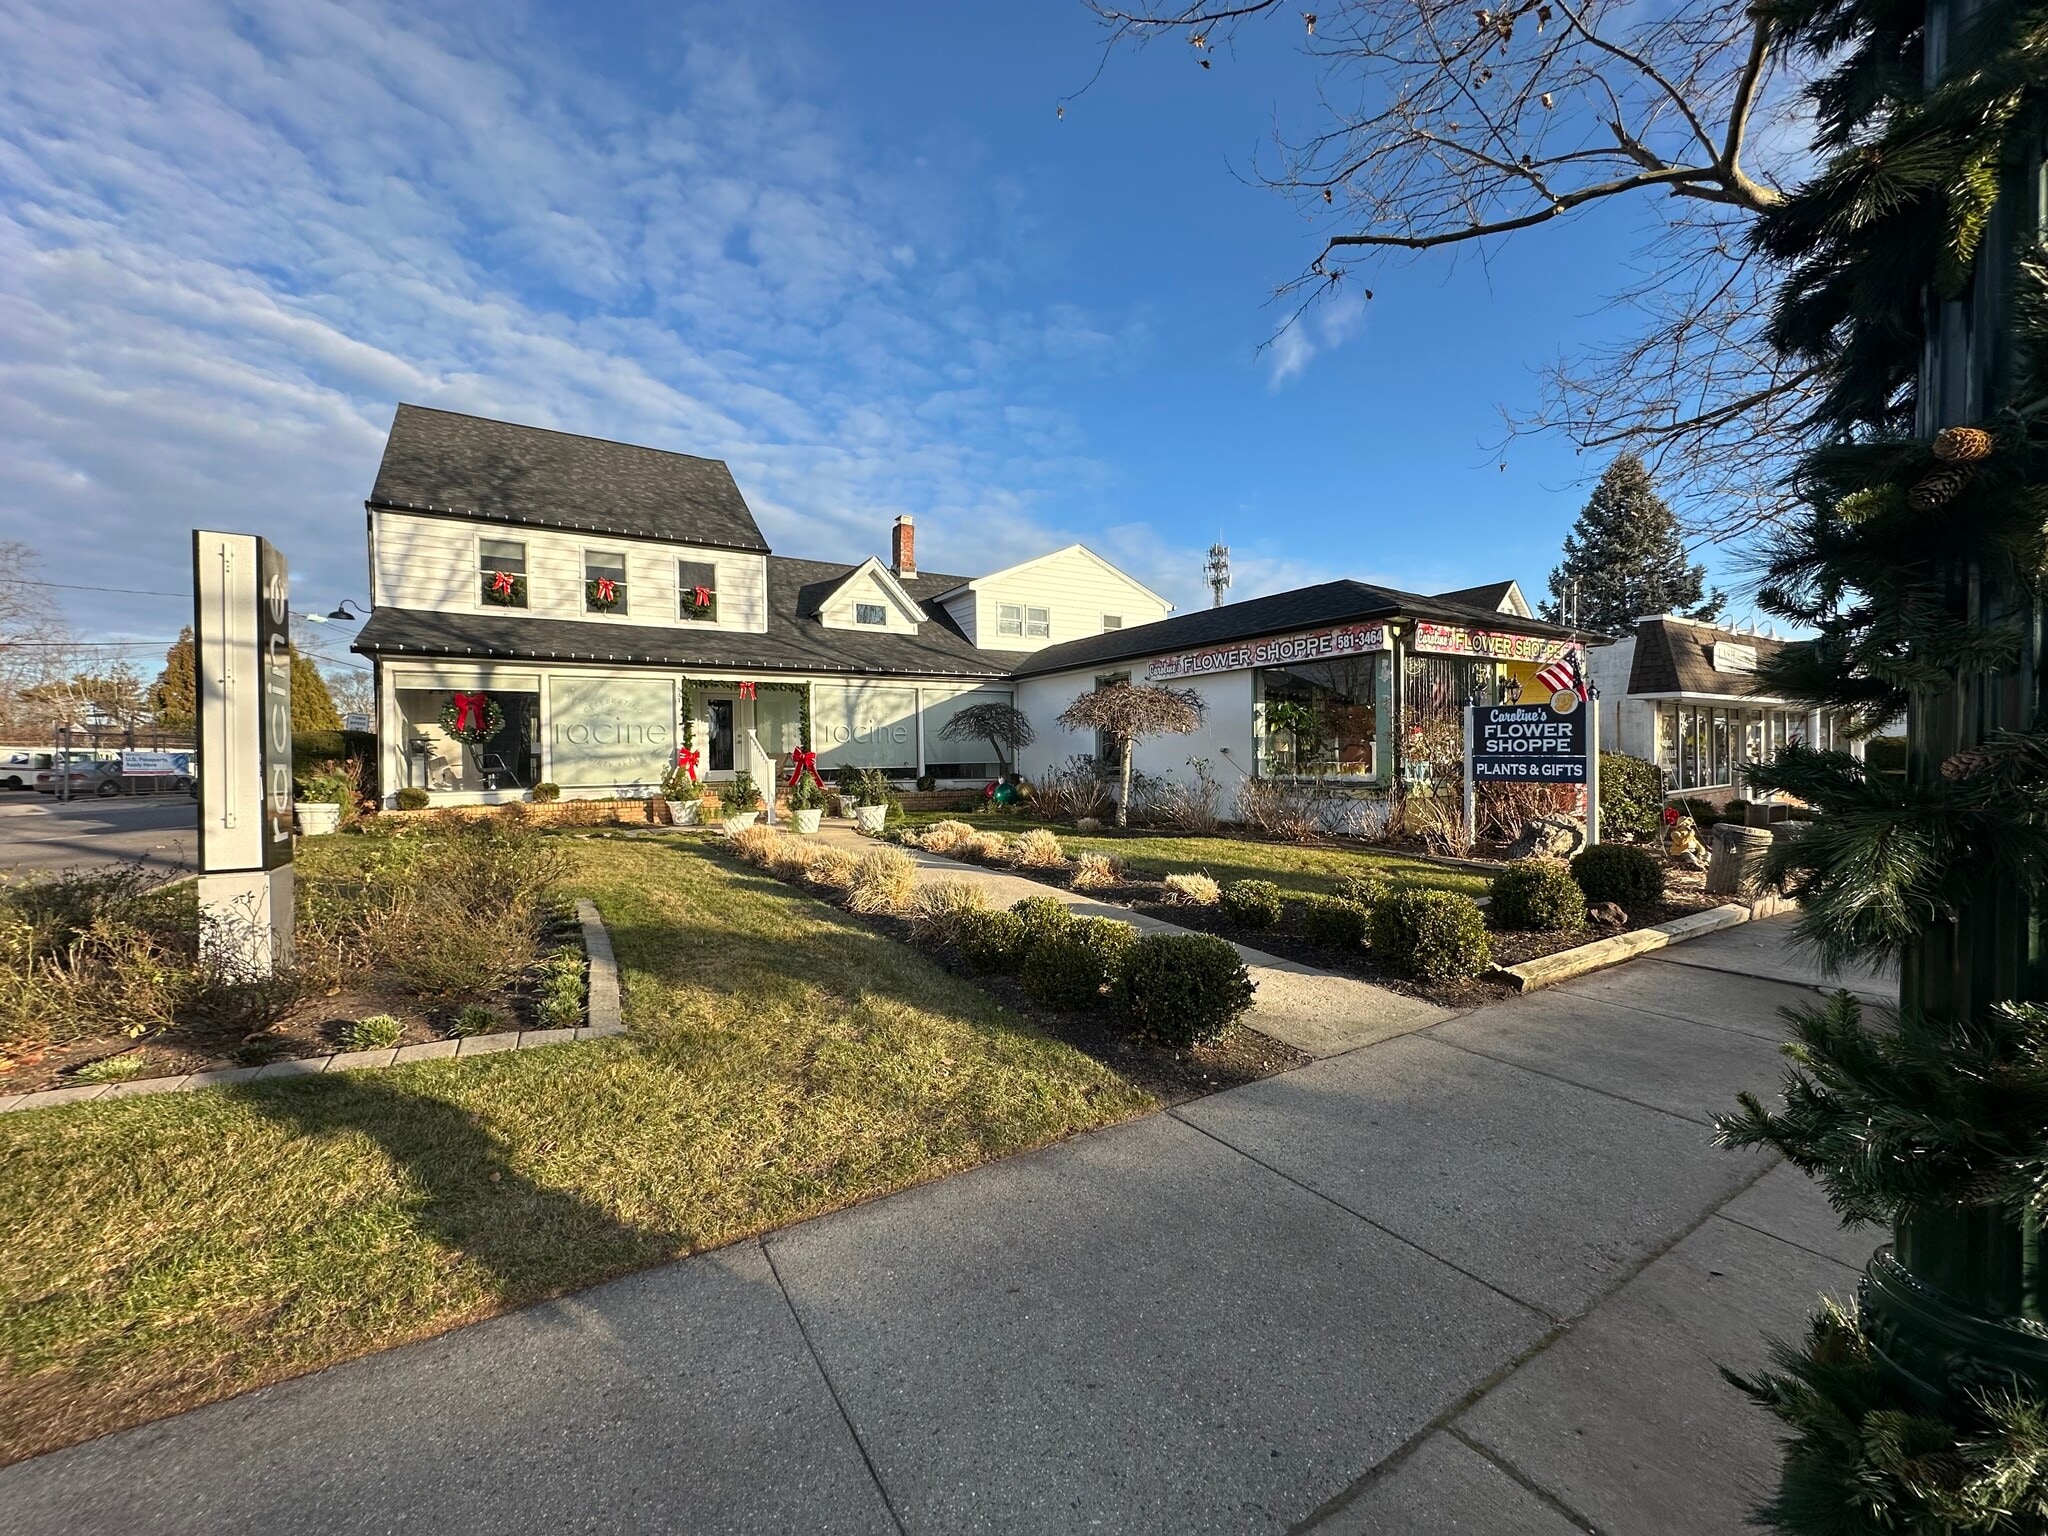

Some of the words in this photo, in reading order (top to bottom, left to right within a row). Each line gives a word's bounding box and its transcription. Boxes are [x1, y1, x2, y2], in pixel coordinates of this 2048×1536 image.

[1418, 629, 1453, 647] Caroline's
[1455, 632, 1512, 655] FLOWER
[1149, 659, 1182, 677] Caroline's
[1183, 648, 1251, 673] FLOWER
[1255, 635, 1332, 662] SHOPPE
[1337, 628, 1384, 649] 581-3464
[268, 574, 288, 842] racine
[583, 698, 644, 714] CELEBRATING
[1490, 707, 1547, 722] Caroline's
[555, 717, 667, 744] racine
[825, 719, 907, 743] racine
[1484, 722, 1573, 738] FLOWER
[1486, 738, 1571, 753] SHOPPE
[1476, 763, 1527, 775] PLANTS
[1529, 764, 1539, 775] &
[1541, 764, 1583, 776] GIFTS
